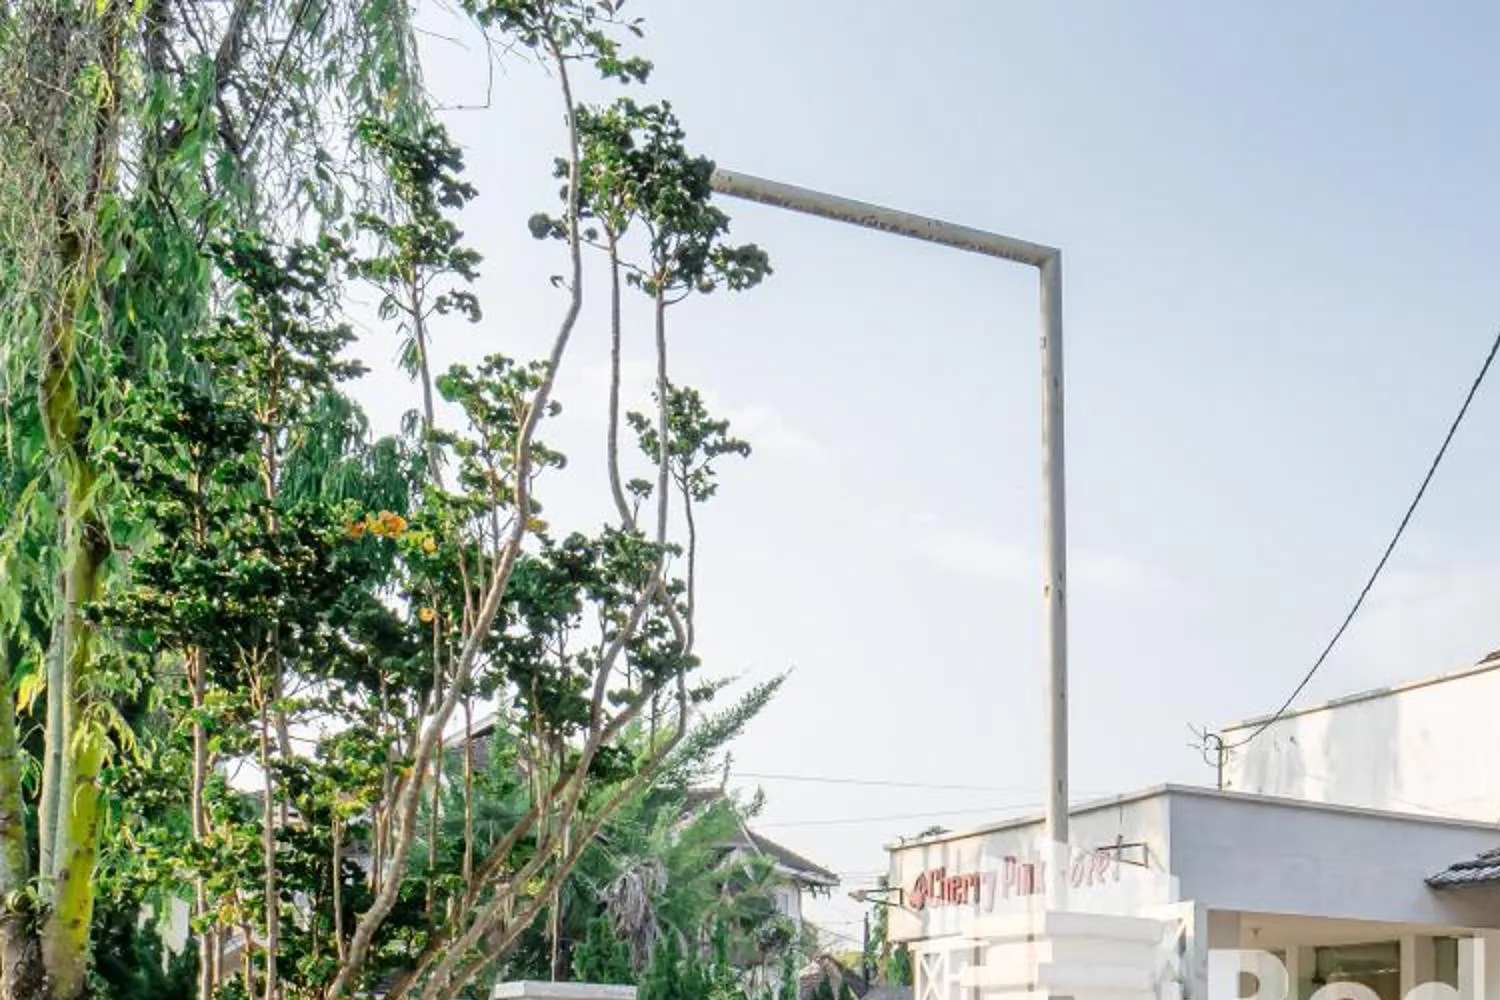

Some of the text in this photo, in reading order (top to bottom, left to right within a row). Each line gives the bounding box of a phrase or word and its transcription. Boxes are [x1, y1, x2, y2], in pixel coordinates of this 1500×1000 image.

[928, 835, 1123, 912] Cherry Pink otel
